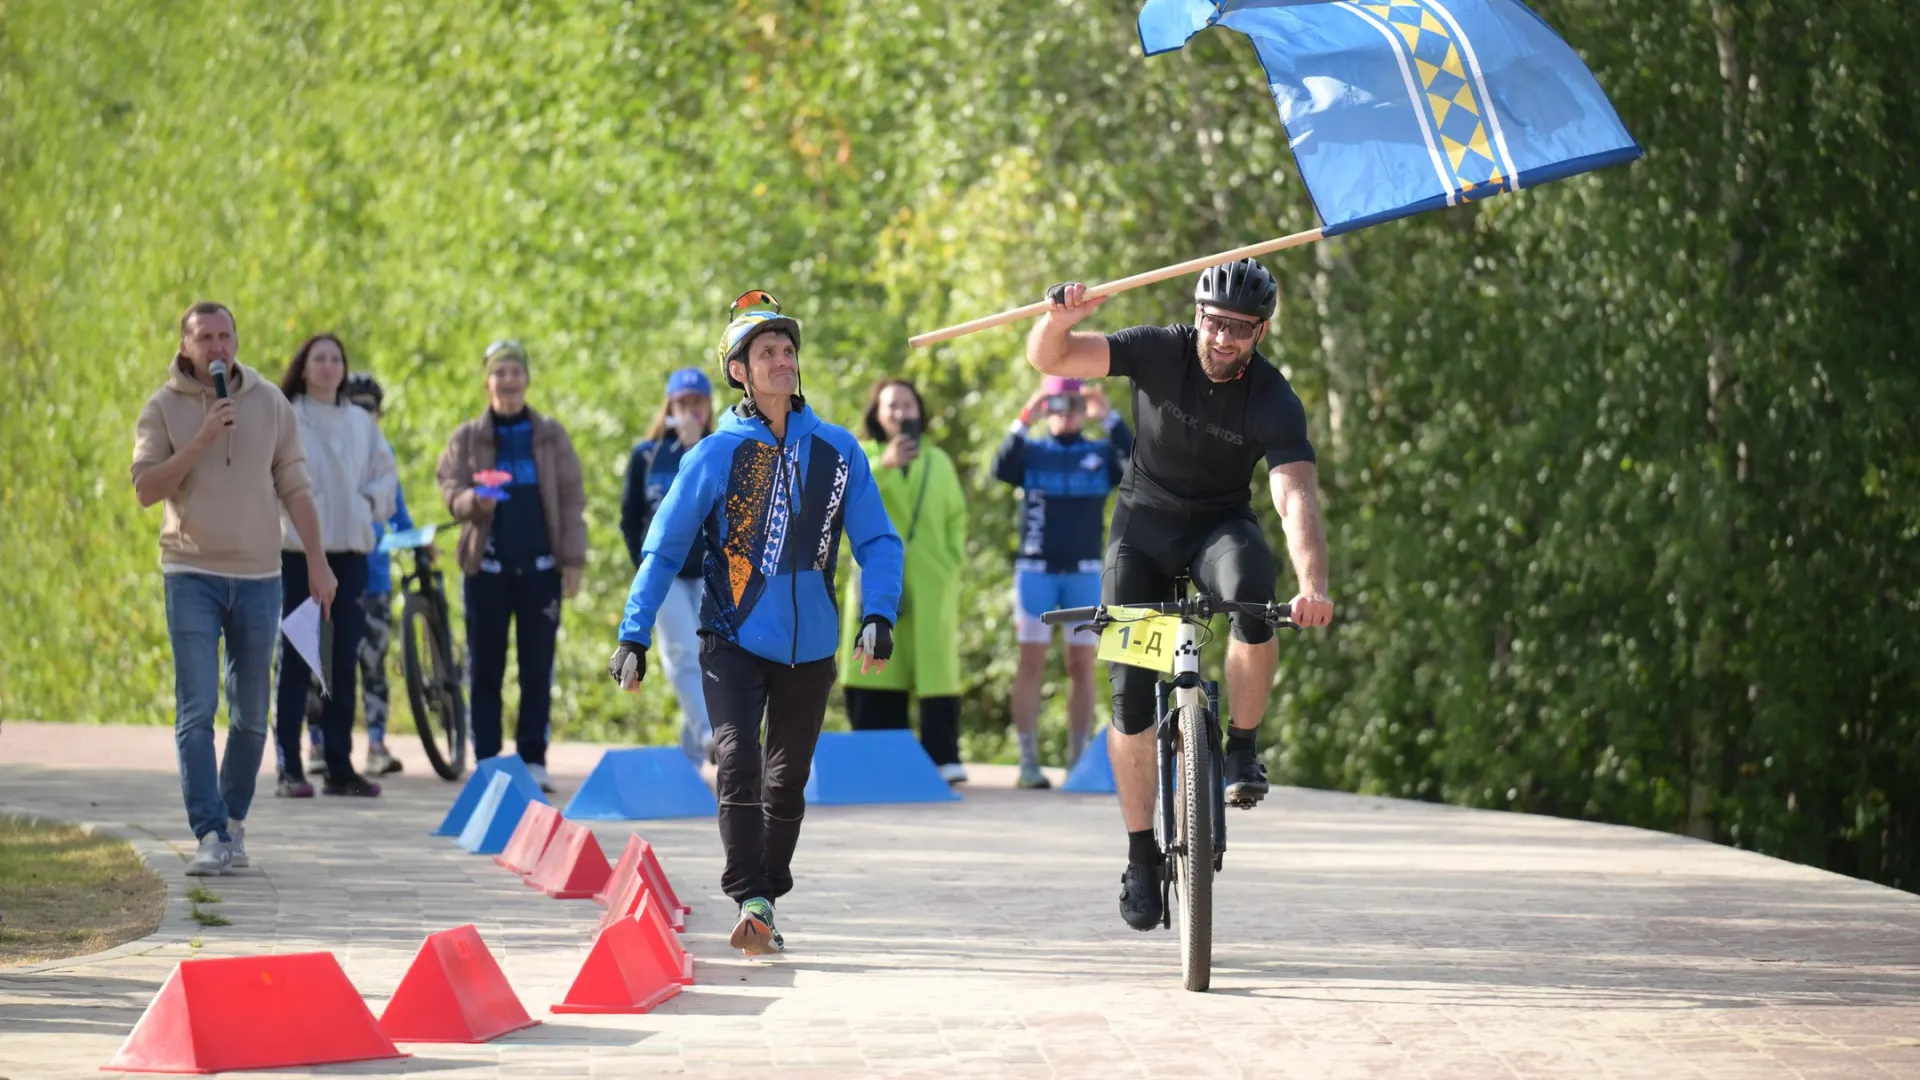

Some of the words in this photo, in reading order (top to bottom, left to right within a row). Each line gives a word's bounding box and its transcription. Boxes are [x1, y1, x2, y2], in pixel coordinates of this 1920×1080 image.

[1162, 400, 1199, 428] ROCK
[1205, 423, 1244, 445] BROS
[1118, 626, 1162, 657] 1-Д
